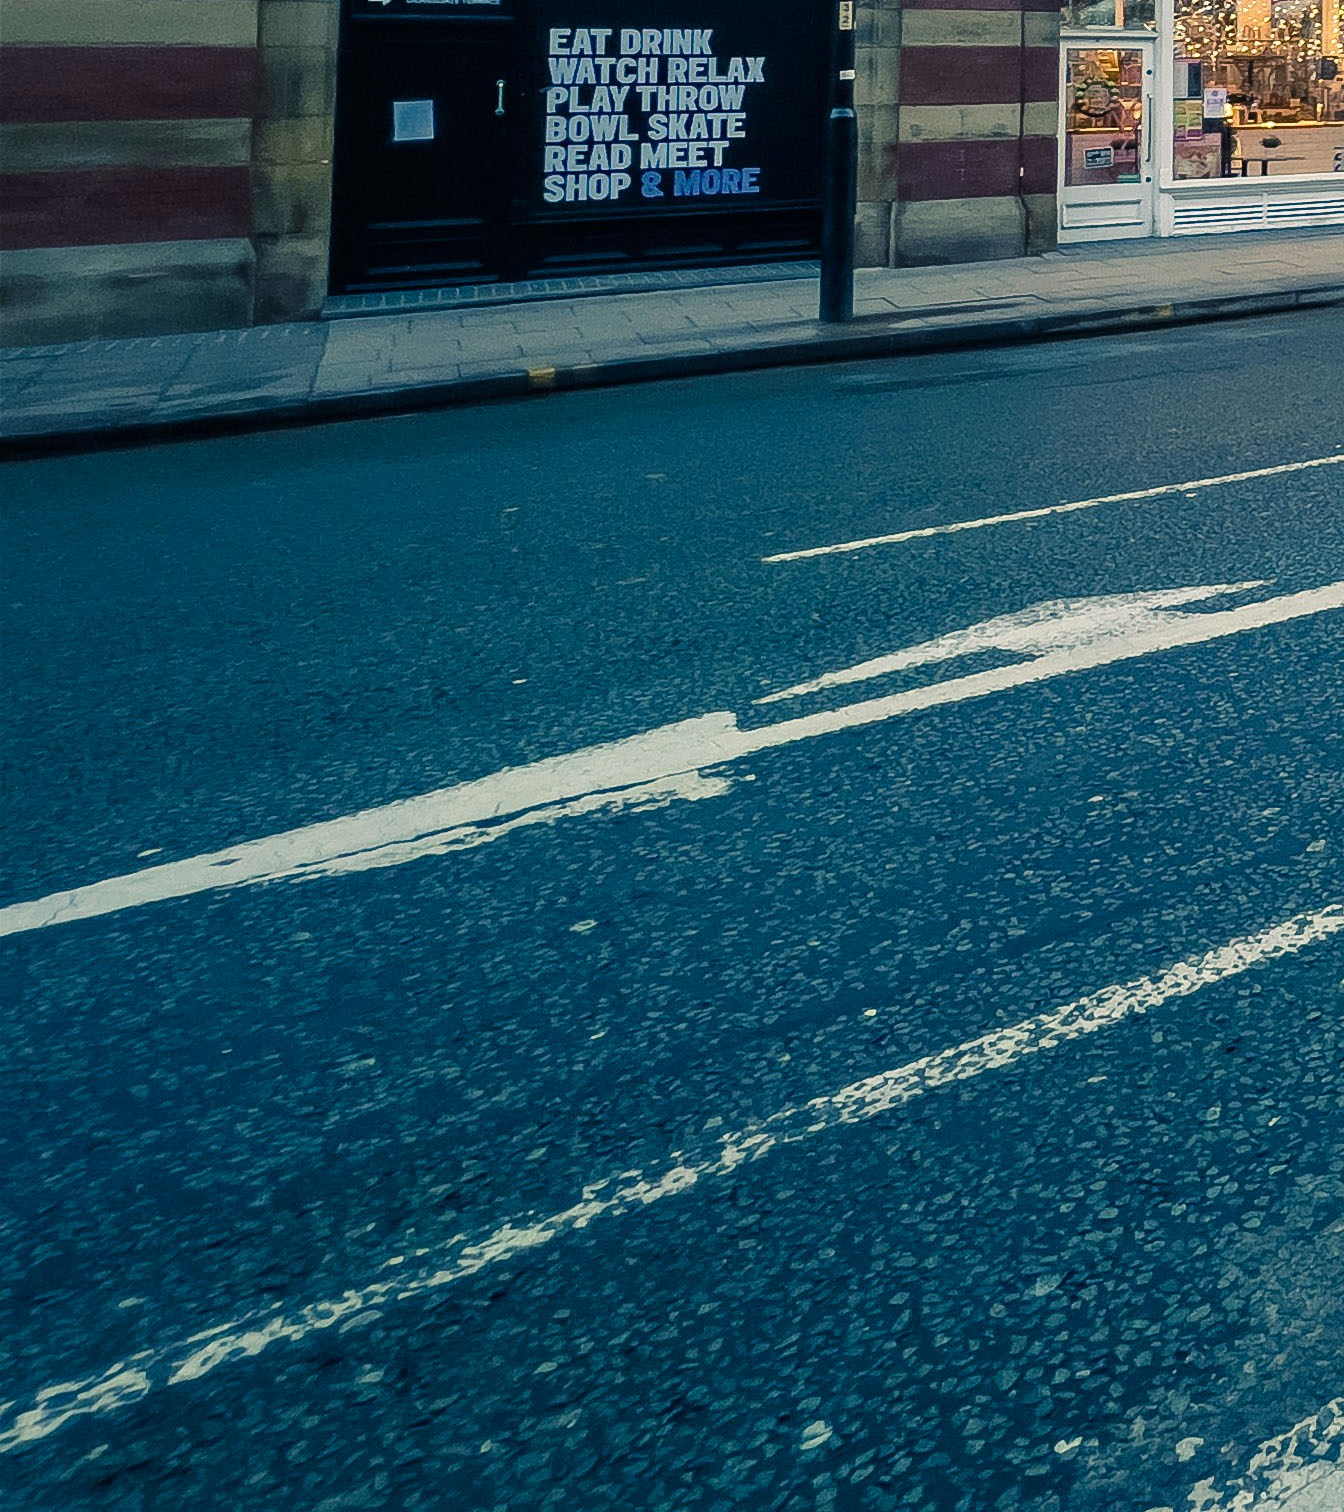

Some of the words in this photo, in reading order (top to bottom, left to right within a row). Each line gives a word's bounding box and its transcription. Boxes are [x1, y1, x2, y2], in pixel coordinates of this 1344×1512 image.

[549, 28, 612, 55] EAT
[620, 28, 713, 55] DRINK
[548, 57, 658, 85] WATCH
[667, 57, 765, 84] RELAX
[546, 86, 631, 114] PLAY
[635, 85, 745, 112] THROW
[545, 114, 639, 142] BOWL
[648, 113, 746, 139] SKATE
[544, 144, 632, 172] READ
[639, 141, 730, 169] MEET
[543, 173, 632, 202] SHOP
[641, 170, 664, 198] &
[673, 168, 760, 197] MORE
